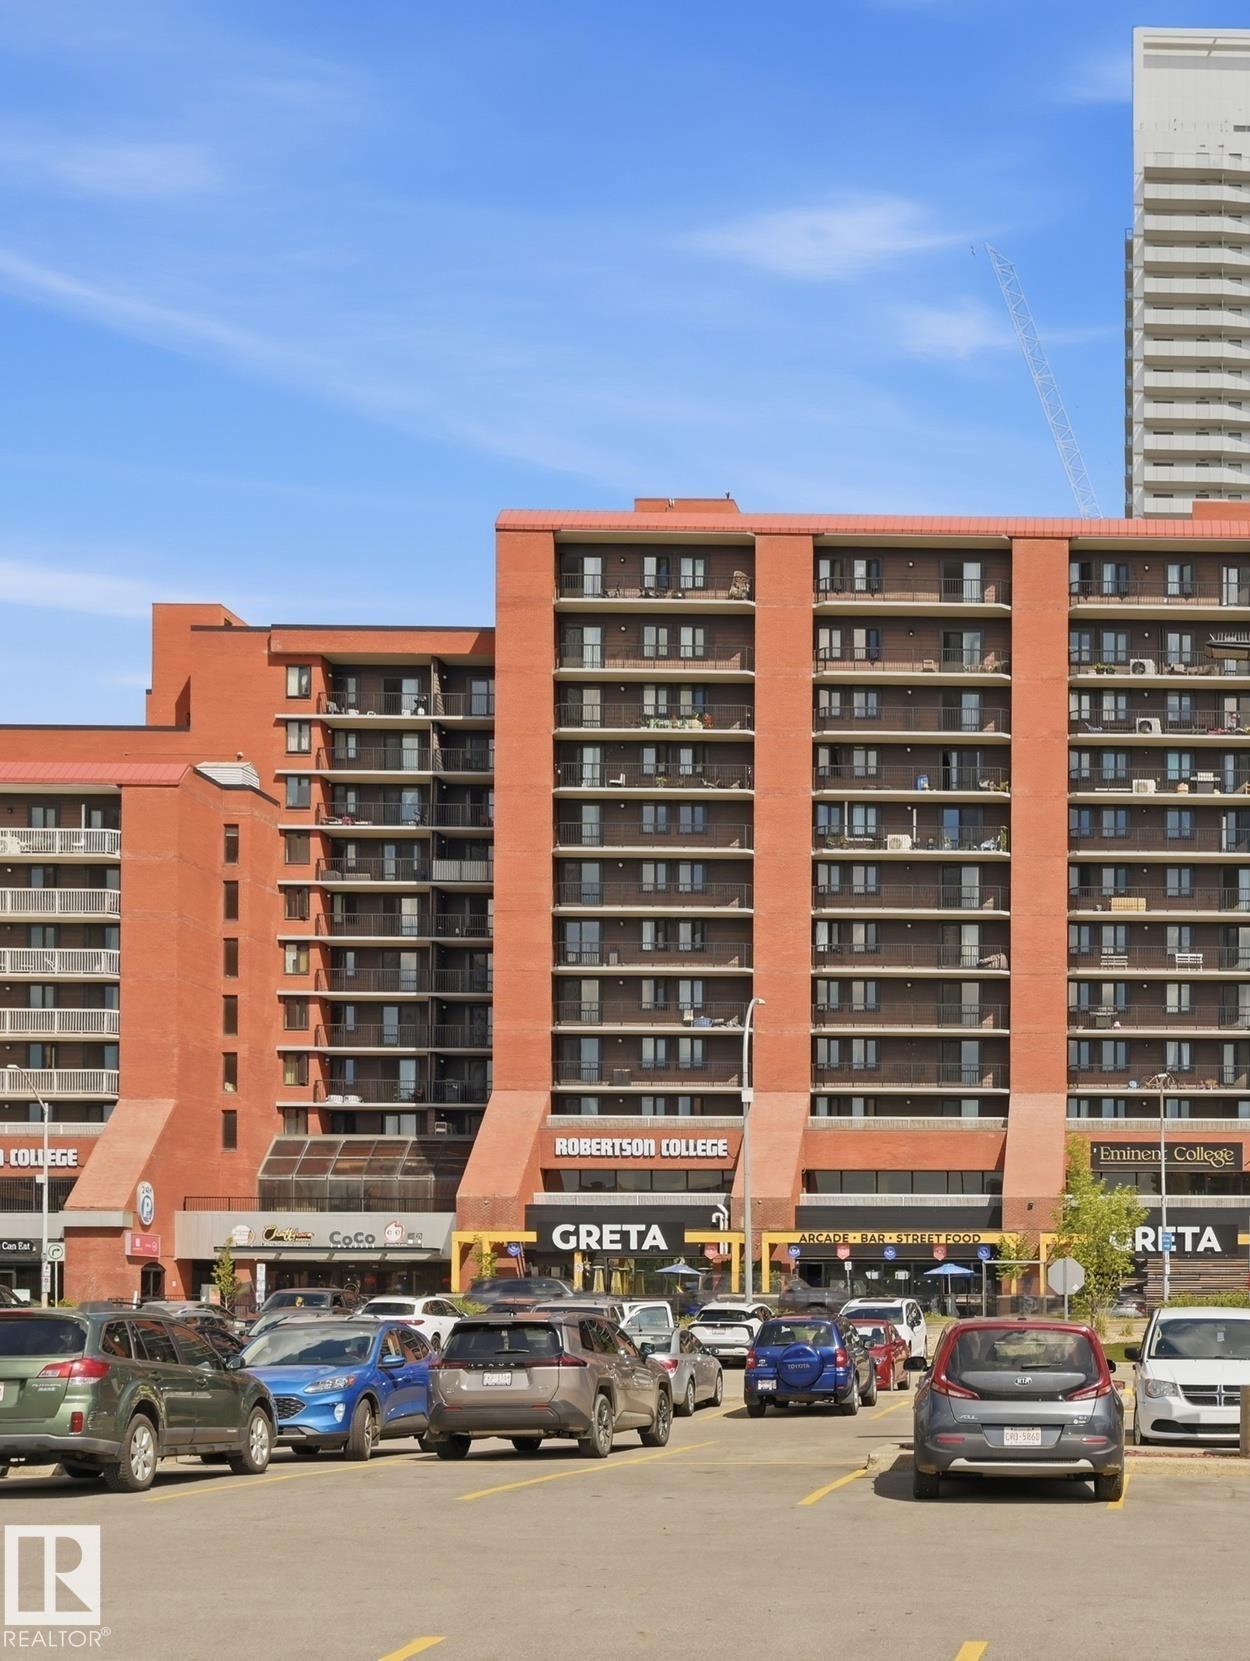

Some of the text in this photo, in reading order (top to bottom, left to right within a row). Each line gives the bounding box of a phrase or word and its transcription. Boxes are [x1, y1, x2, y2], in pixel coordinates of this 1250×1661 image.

[555, 1138, 728, 1157] ROBERTSON COLLEGE
[1174, 1146, 1234, 1168] College
[10, 1148, 78, 1167] COLLEGE
[2, 1242, 31, 1250] Can Eat
[552, 1224, 668, 1250] GRETA
[800, 1233, 981, 1243] ARCADE BAR STREET FOOD
